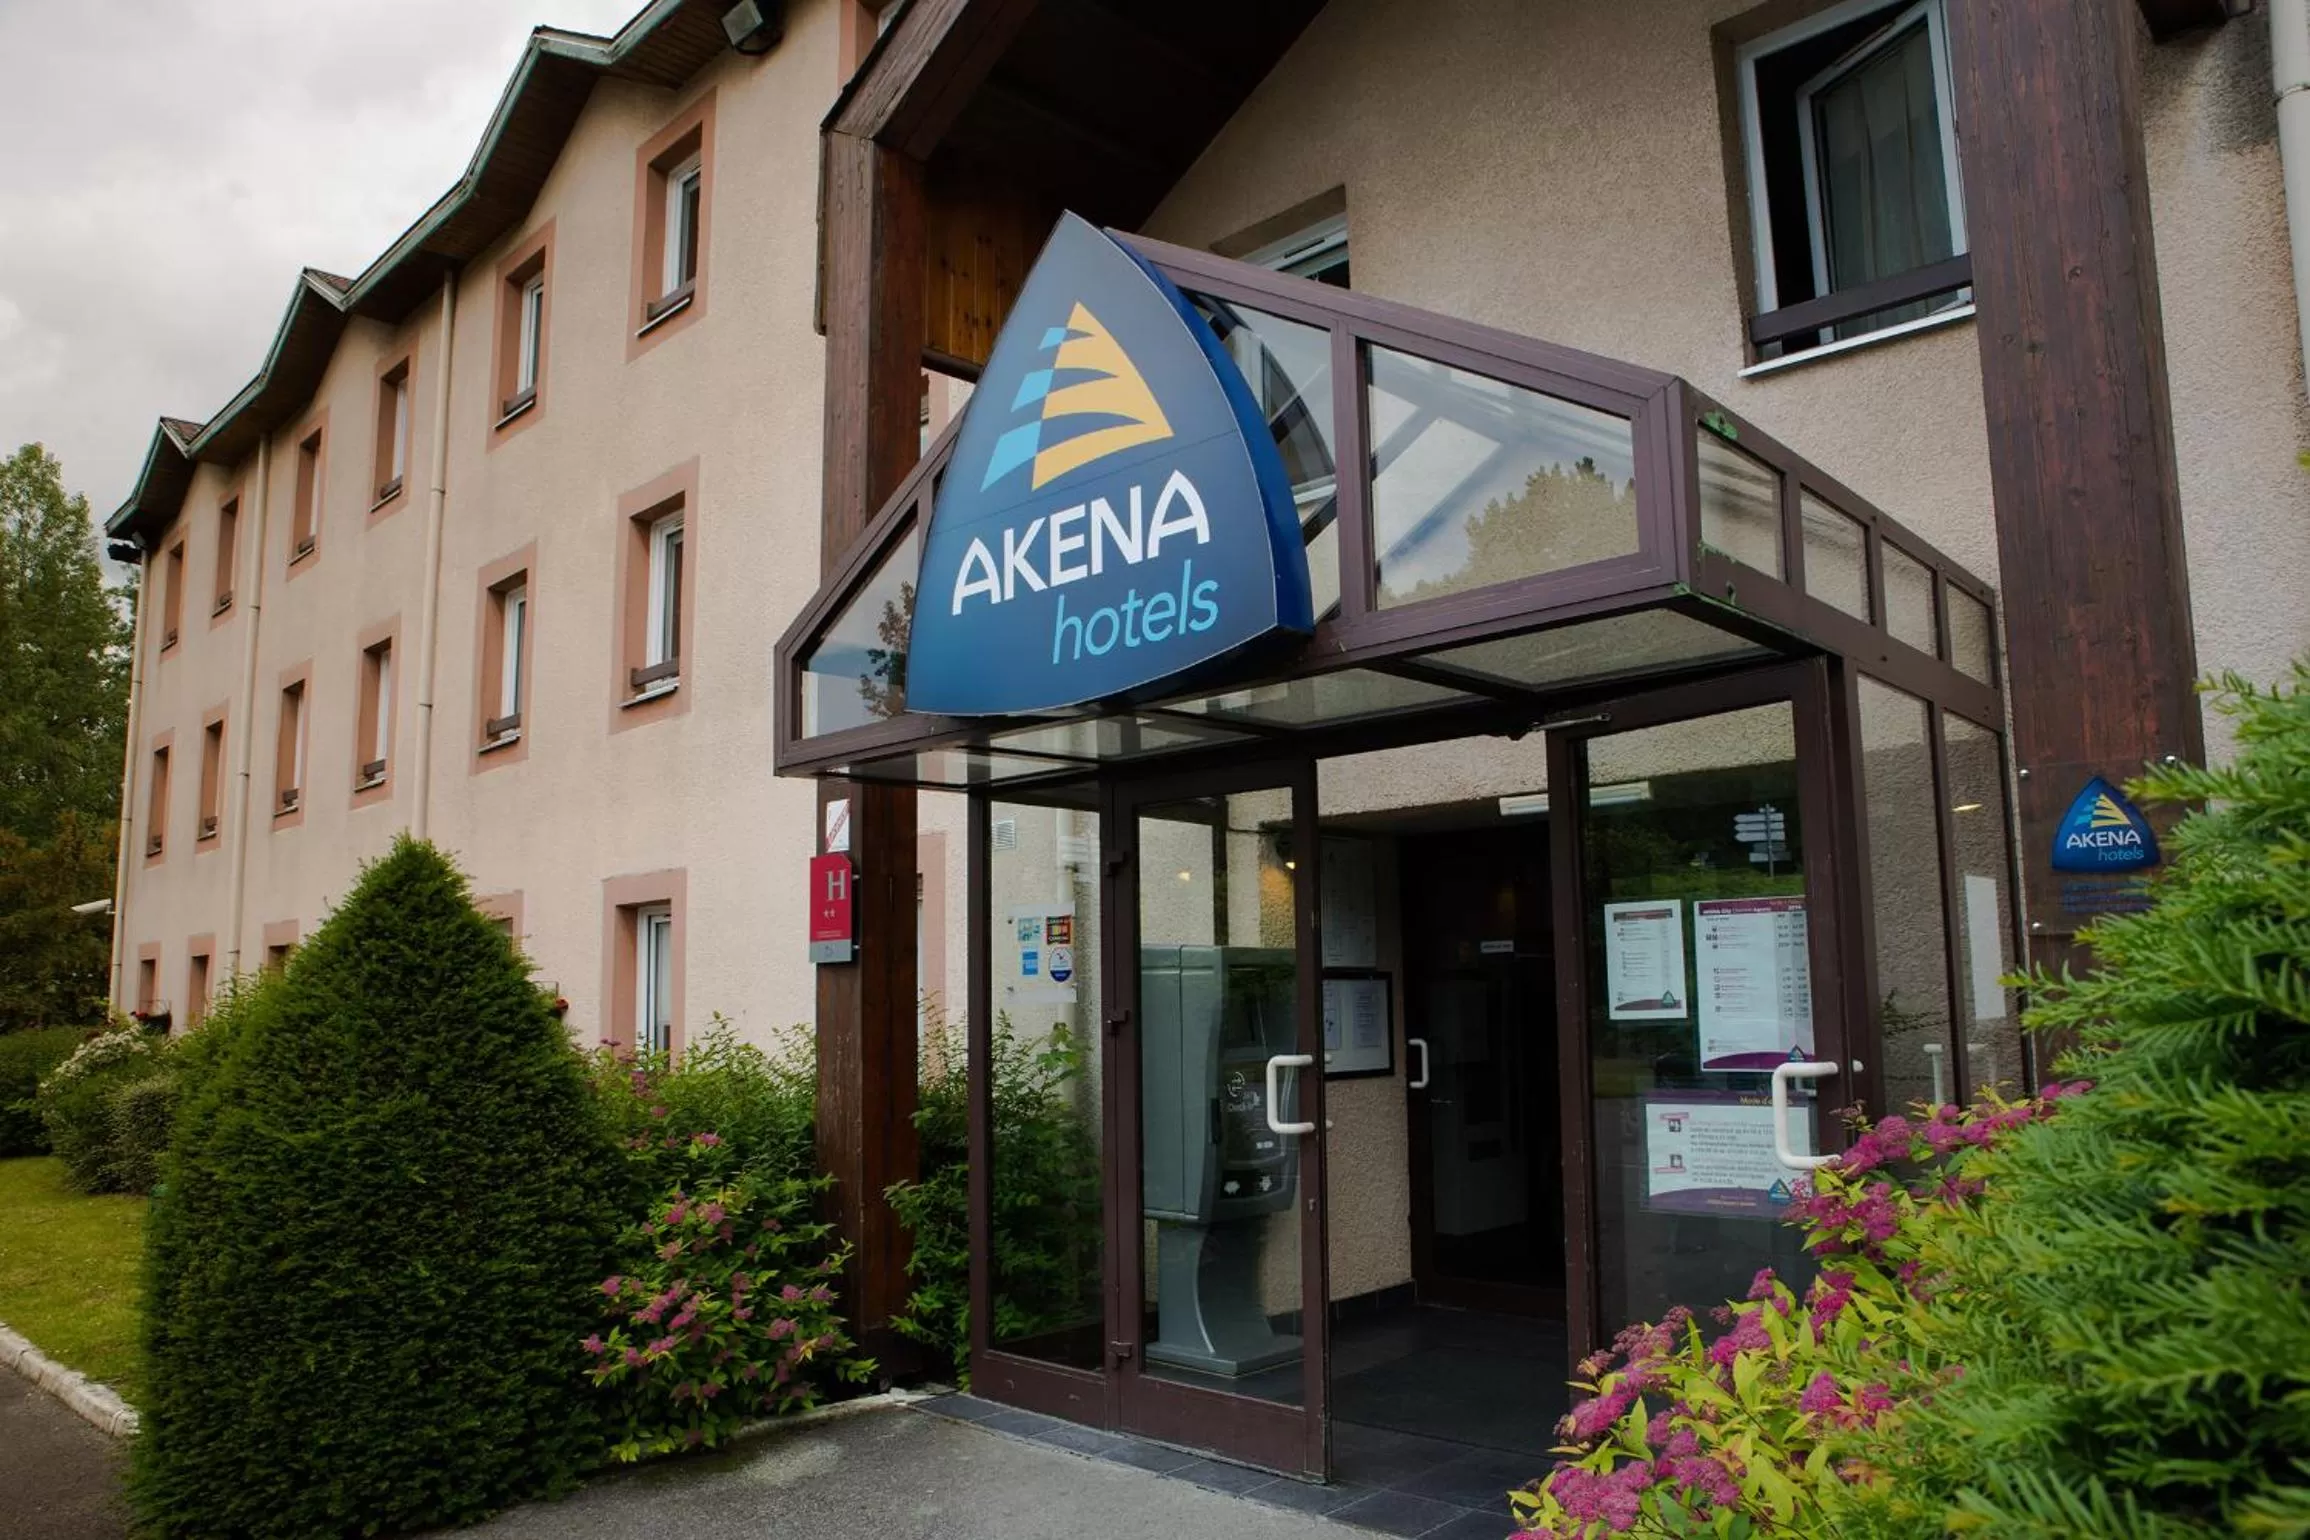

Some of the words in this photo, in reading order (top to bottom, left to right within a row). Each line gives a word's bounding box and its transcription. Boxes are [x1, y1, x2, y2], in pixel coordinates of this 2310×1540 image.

[952, 469, 1210, 616] AKENA
[1052, 558, 1220, 664] hotels
[2066, 829, 2142, 849] AKENA
[2098, 845, 2145, 861] hotels
[825, 869, 848, 901] H
